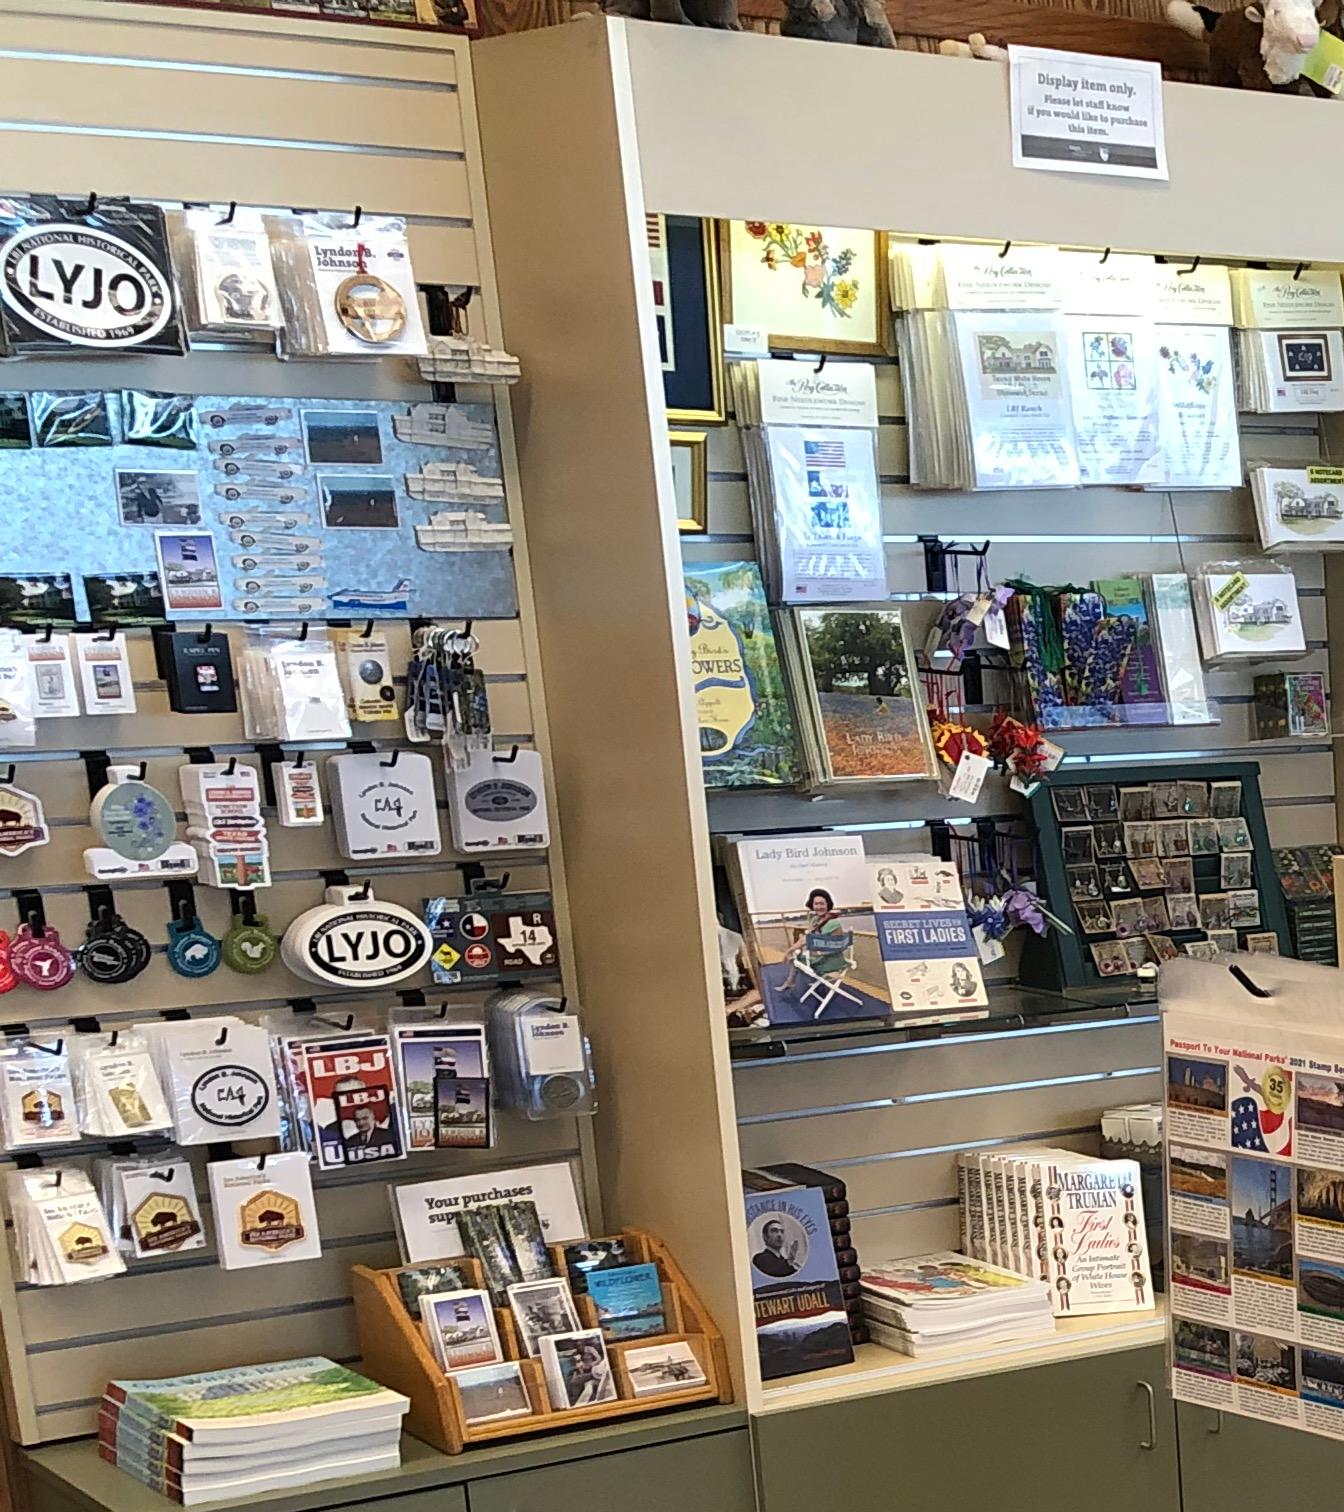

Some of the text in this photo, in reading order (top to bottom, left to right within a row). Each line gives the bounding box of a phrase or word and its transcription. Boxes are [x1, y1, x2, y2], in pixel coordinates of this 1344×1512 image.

[1038, 73, 1136, 98] Display item only.
[1044, 95, 1129, 111] Please let staff know
[22, 235, 75, 254] NATIONAL
[314, 246, 360, 259] Lyndon
[28, 253, 146, 318] LYJO
[755, 846, 857, 860] Lady Bird Johnson
[520, 930, 537, 943] 14
[885, 927, 966, 945] FIRST LADIES
[325, 929, 412, 963] LYJO
[311, 1053, 386, 1078] LBJ
[339, 1089, 386, 1106] LBJ
[348, 1143, 397, 1162] USA
[424, 1183, 534, 1212] Your purchases
[1067, 1191, 1119, 1210] TRUMAN
[1075, 1210, 1114, 1236] First
[1071, 1231, 1120, 1255] Ladies
[755, 1291, 830, 1319] TEWART UDALL
